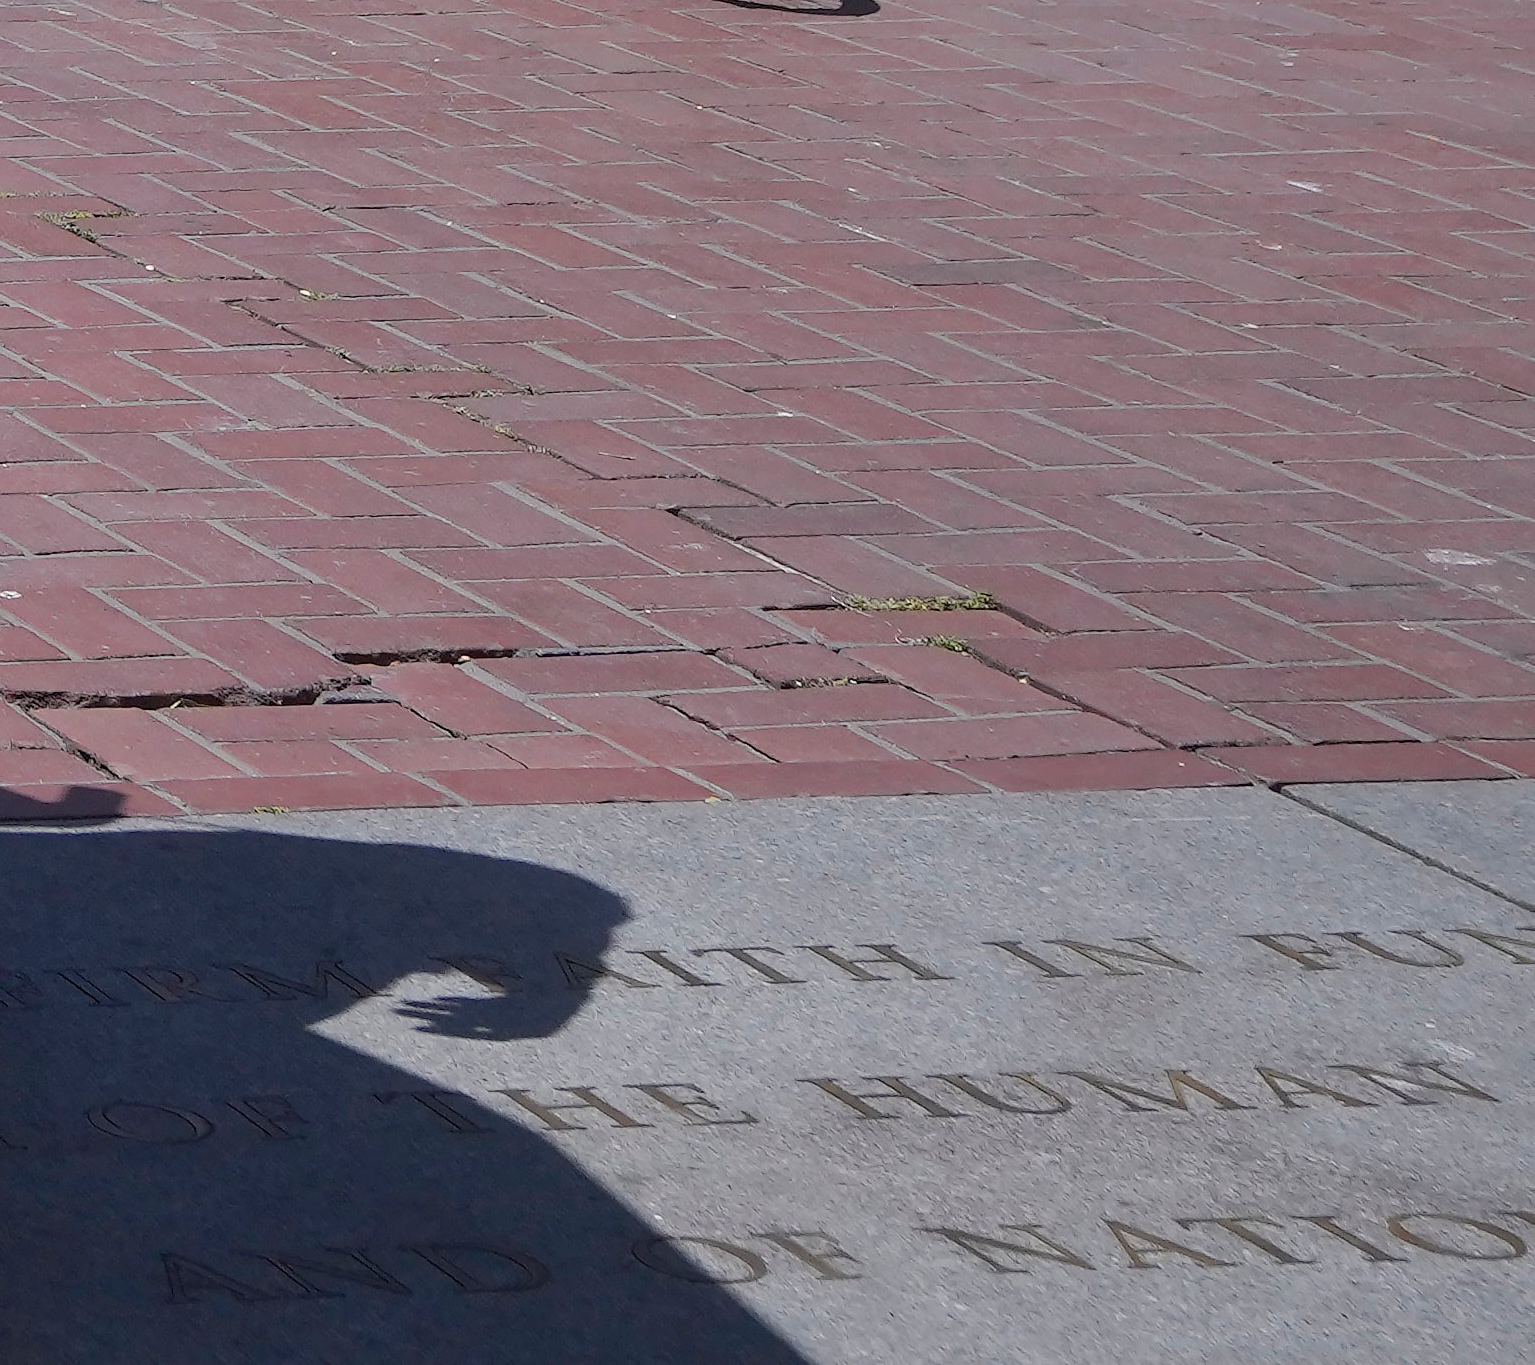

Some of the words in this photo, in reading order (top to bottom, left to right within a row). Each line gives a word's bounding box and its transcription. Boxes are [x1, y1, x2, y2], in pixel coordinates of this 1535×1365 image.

[427, 941, 956, 993] FAITH
[982, 937, 1202, 979] IN
[84, 1093, 308, 1147] OF
[374, 1082, 759, 1135] THE
[796, 1061, 1501, 1121] HUMAN
[160, 1239, 551, 1305] AND
[631, 1228, 863, 1285] OF
[916, 1211, 1535, 1273] NATIO
